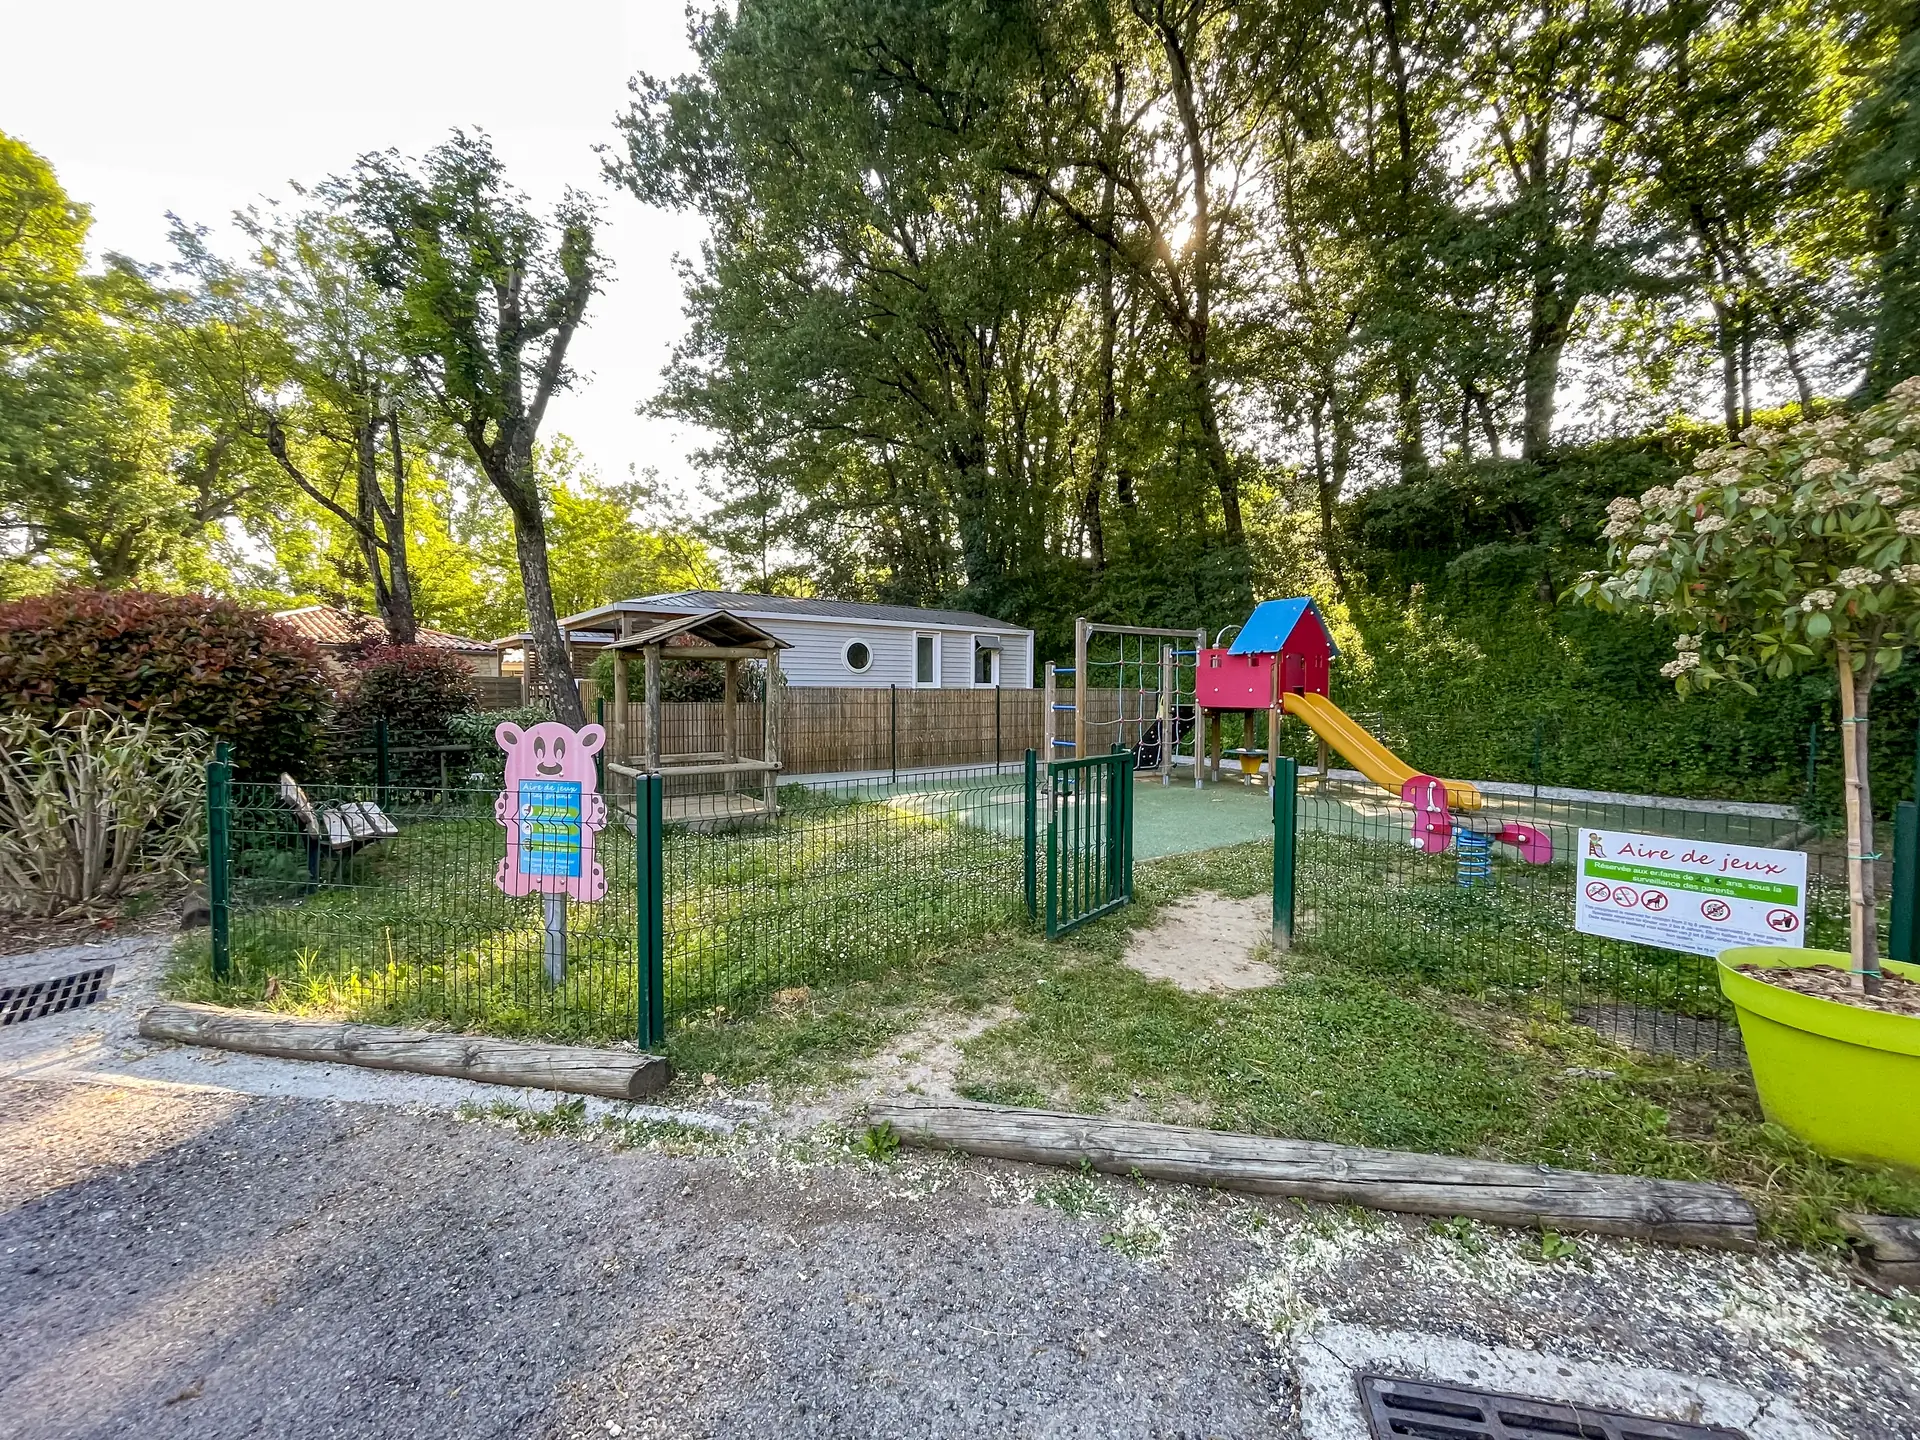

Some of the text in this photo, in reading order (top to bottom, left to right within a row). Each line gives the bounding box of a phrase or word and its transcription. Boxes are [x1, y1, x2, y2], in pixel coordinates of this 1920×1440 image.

[557, 784, 578, 792] jeux
[1617, 843, 1787, 875] Aire de jeux
[1595, 862, 1632, 873] Réservée
[1748, 883, 1771, 892] sous
[1773, 885, 1782, 893] la
[1633, 876, 1681, 888] surveillance
[1683, 883, 1700, 891] des
